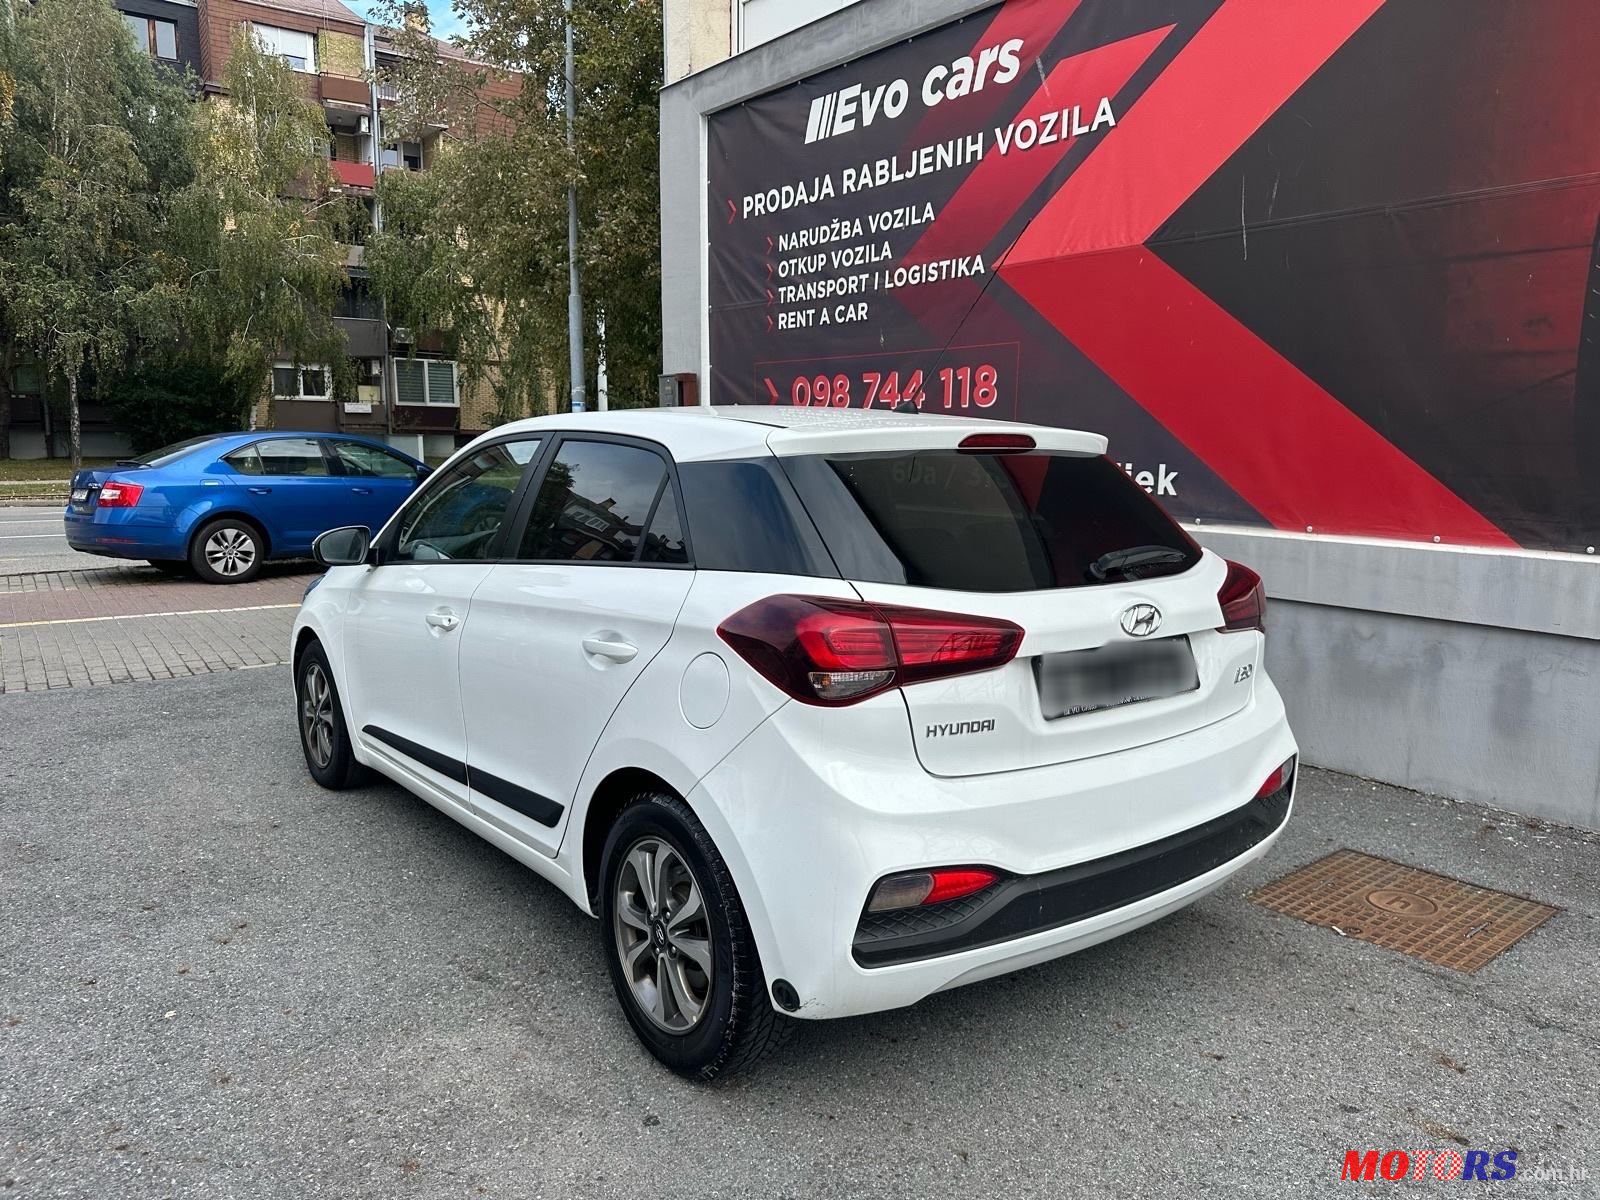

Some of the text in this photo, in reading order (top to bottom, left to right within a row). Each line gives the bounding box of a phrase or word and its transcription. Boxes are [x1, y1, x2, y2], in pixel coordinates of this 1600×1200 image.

[832, 38, 1024, 137] Evo cars
[743, 97, 1118, 219] PRODAJA RABLJENIH VOZILA
[778, 202, 935, 252] NARUDŽBA VOZILA
[778, 241, 892, 278] OTKUP VOZILA
[778, 254, 985, 304] TRANSPORT I LOGISTIKA
[778, 302, 868, 330] RENT A CAR
[792, 364, 998, 409] 098 744 118
[925, 719, 995, 738] HYUNDAI
